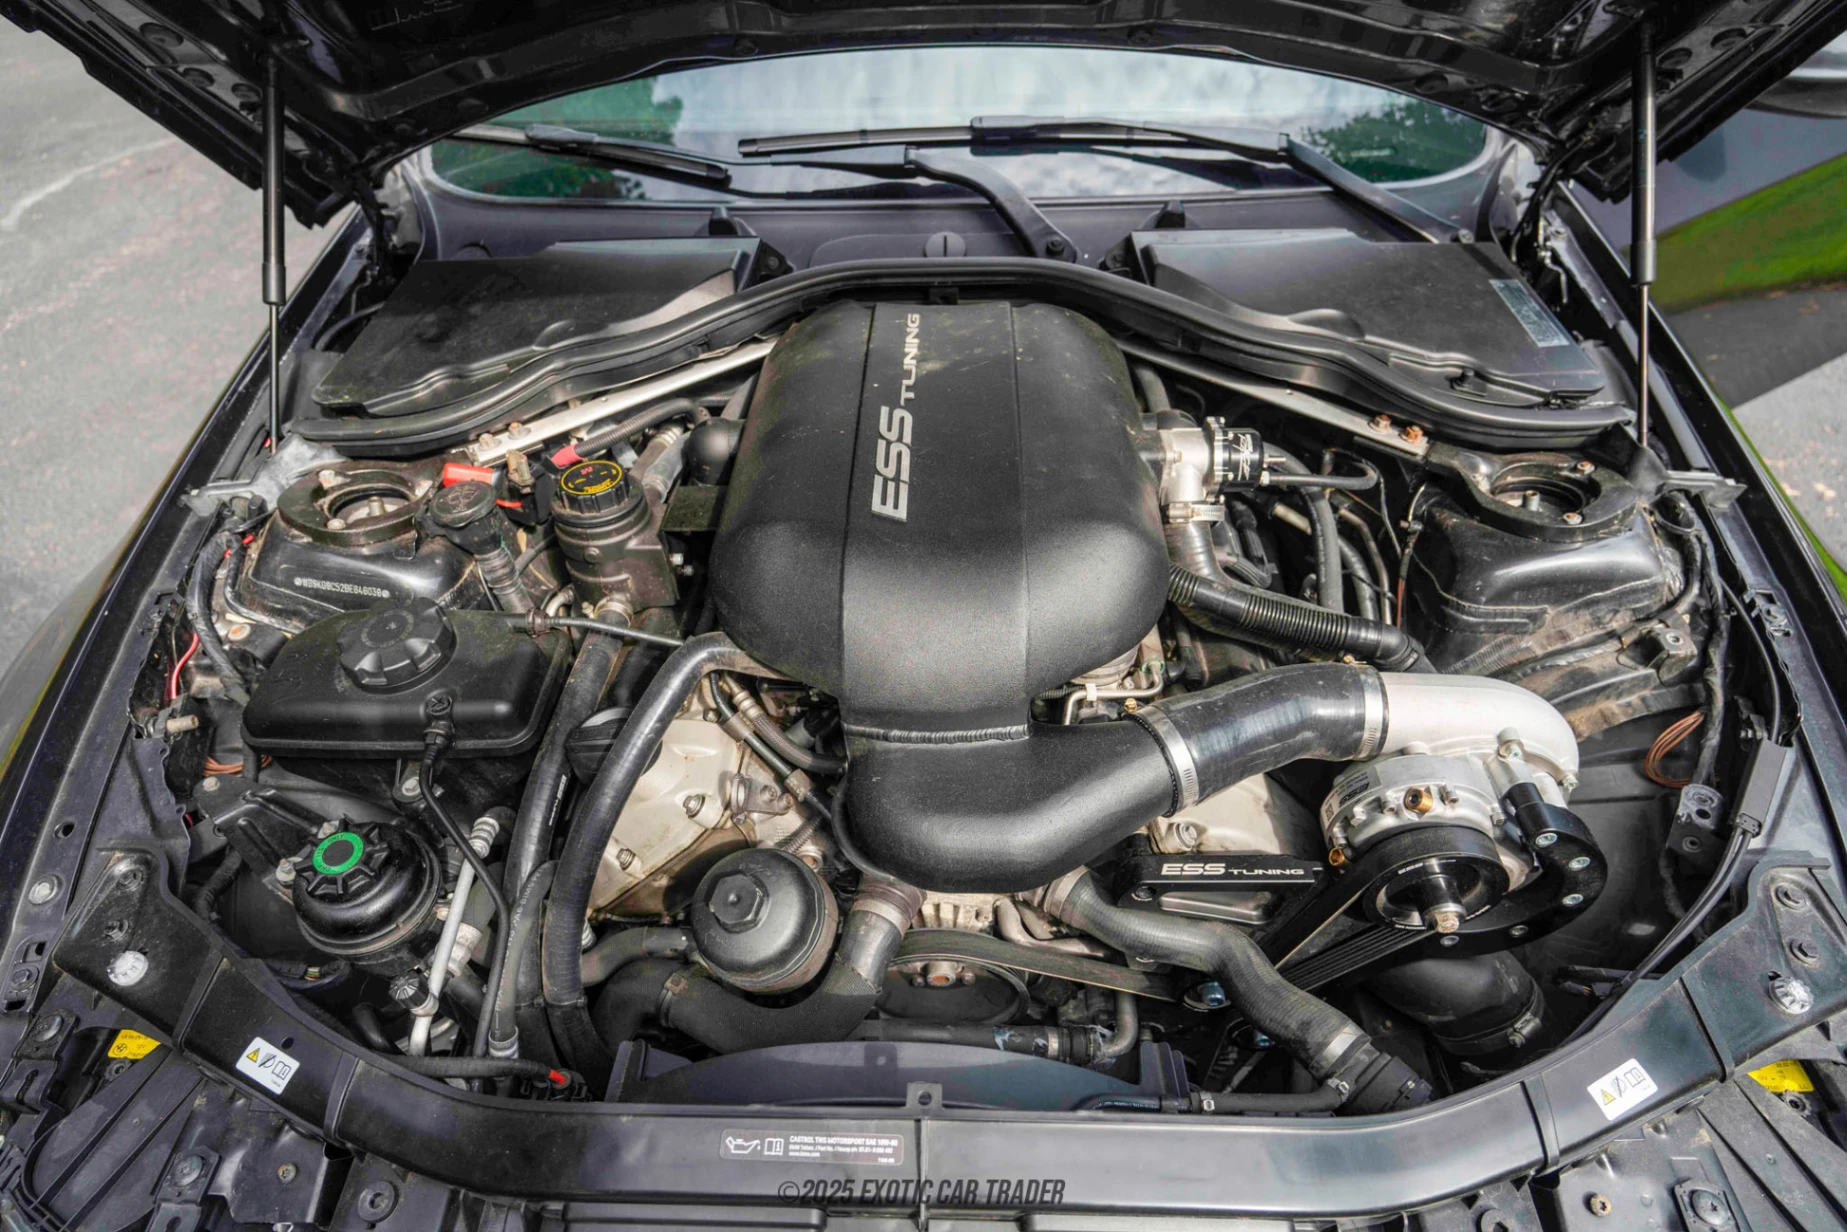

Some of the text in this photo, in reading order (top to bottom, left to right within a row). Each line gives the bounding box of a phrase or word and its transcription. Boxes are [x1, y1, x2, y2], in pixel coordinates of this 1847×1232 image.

[871, 313, 920, 523] ESS TUNING
[1161, 863, 1304, 876] ESS TUNING
[789, 1135, 814, 1143] CASTROL
[828, 1136, 865, 1145] MOTORSPORT
